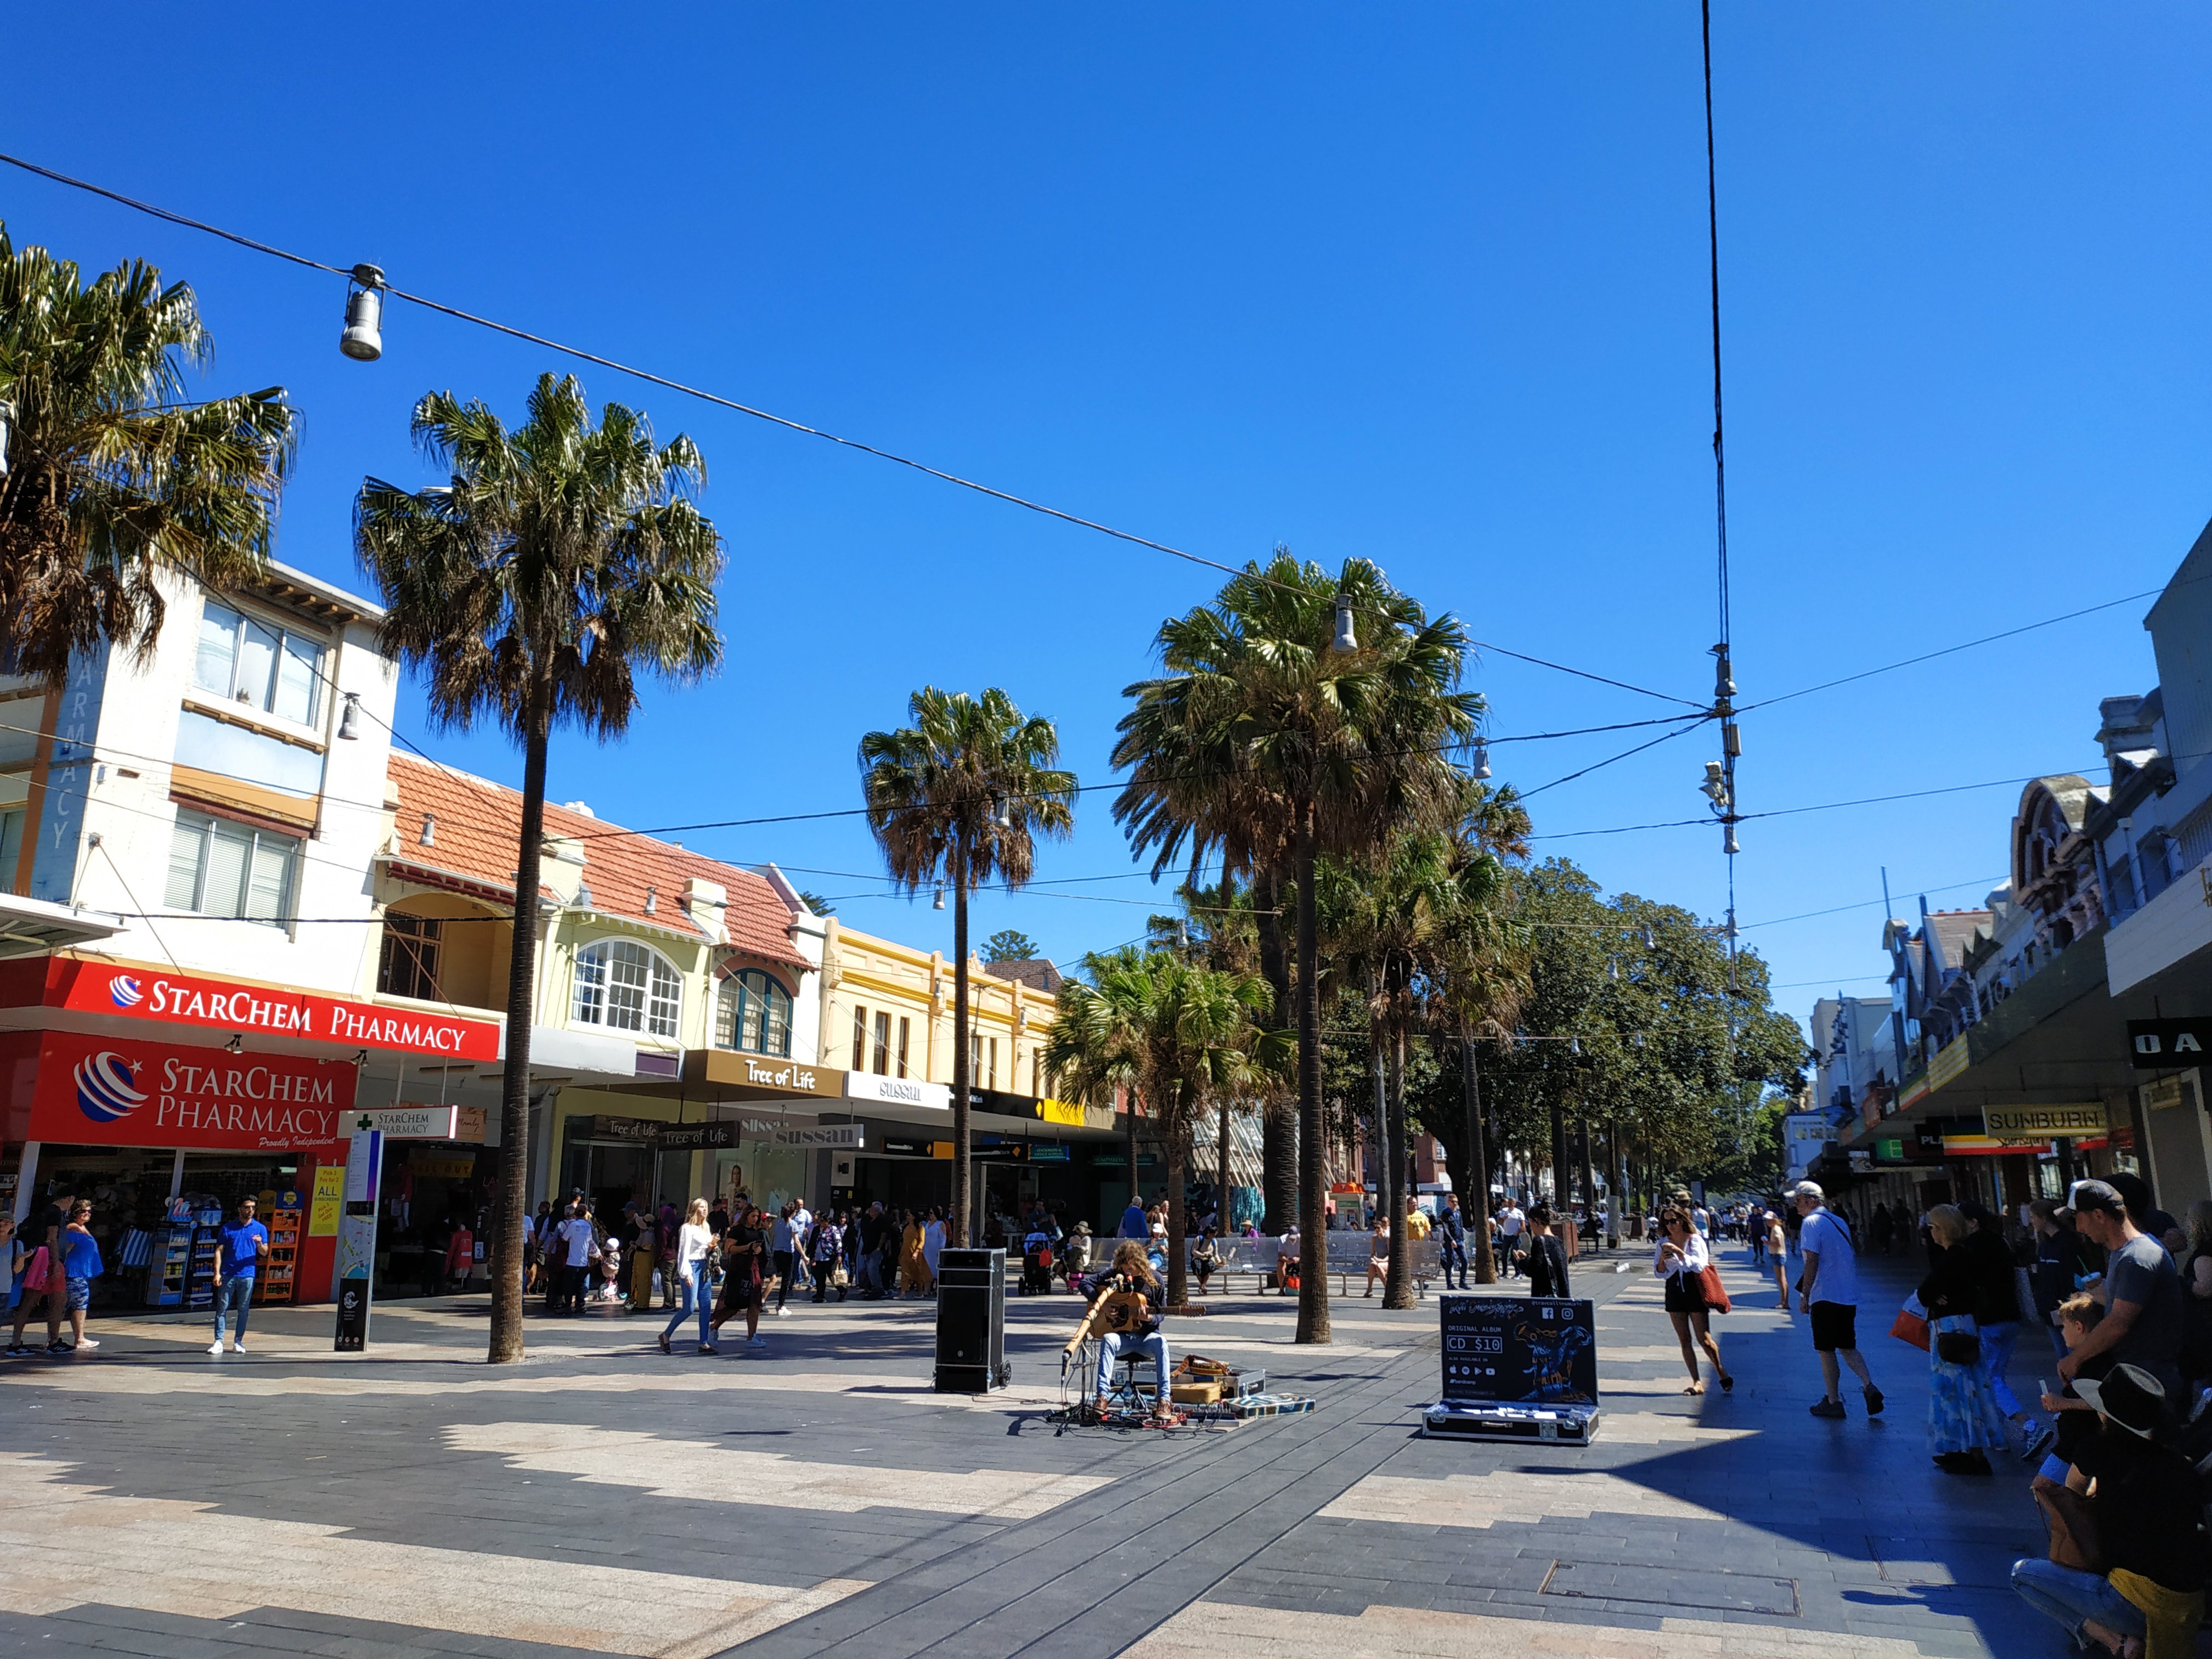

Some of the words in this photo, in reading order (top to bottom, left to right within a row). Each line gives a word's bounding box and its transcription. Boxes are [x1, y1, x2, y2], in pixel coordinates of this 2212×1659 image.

[329, 1006, 466, 1051] PHARMACY
[744, 1059, 772, 1084] Tree
[775, 1068, 791, 1086] of
[793, 1065, 816, 1090] Life
[879, 1081, 922, 1101] sussan
[155, 1094, 334, 1135] PHARMACY
[1989, 1111, 2098, 1130] SUNBURN
[377, 1124, 428, 1135] PHARMACY
[610, 1120, 628, 1135] Tree
[631, 1122, 640, 1136] of
[643, 1123, 657, 1137] Life
[665, 1131, 689, 1143] Tree
[693, 1128, 704, 1144] of
[710, 1128, 728, 1143] Life
[776, 1129, 854, 1144] sussan
[258, 1137, 290, 1149] Proudly
[292, 1135, 336, 1147] Independent
[318, 1186, 337, 1196] ALL
[1449, 1338, 1466, 1349] CD
[1475, 1338, 1500, 1351] $10
